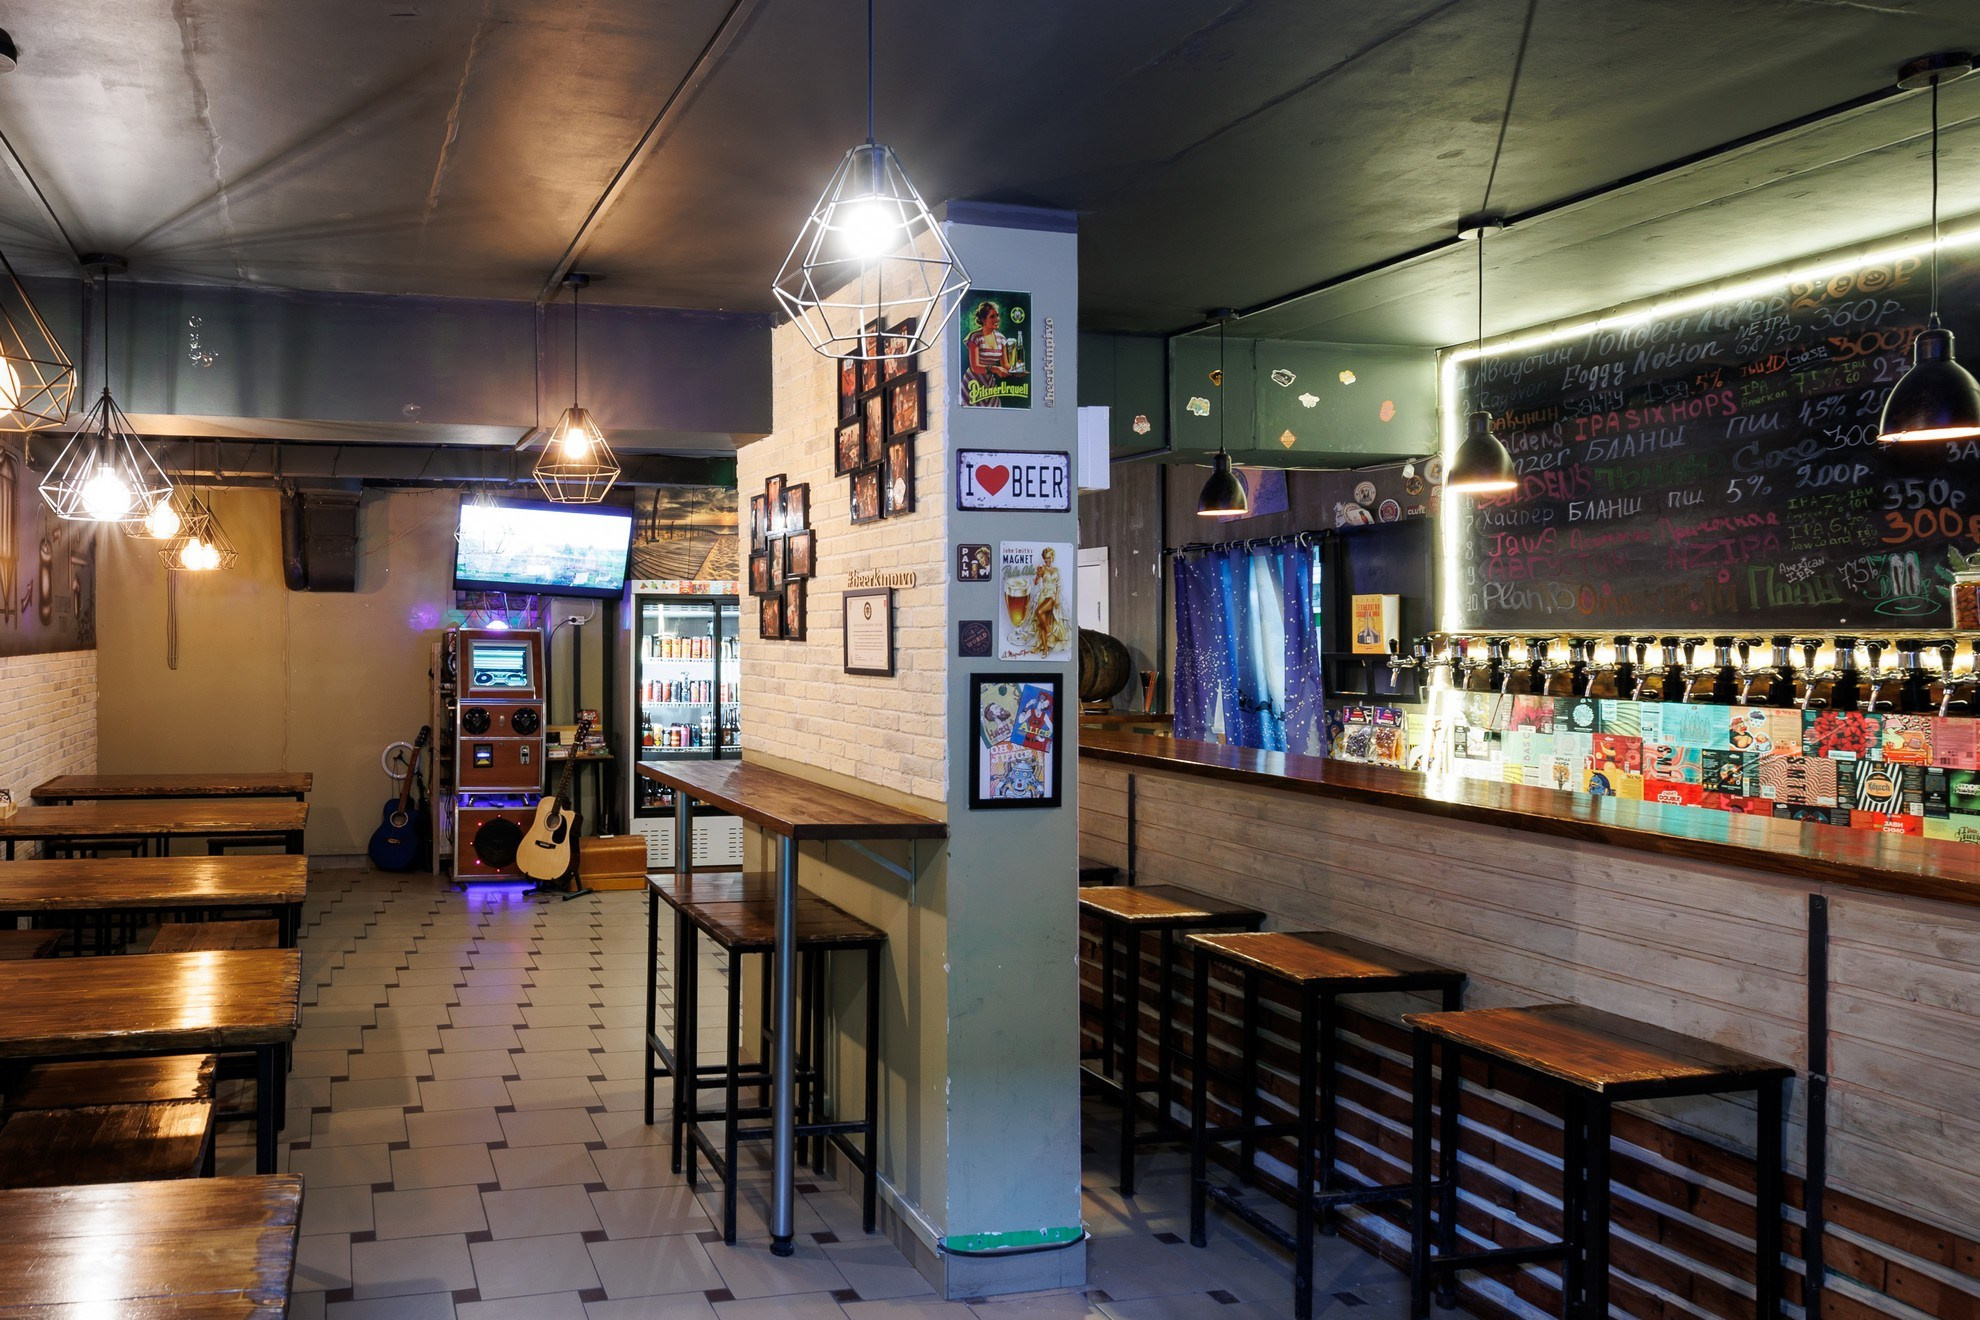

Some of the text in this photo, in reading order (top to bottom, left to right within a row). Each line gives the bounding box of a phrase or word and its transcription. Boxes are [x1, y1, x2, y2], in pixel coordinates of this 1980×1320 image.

[1474, 346, 1573, 386] Августин
[1633, 341, 1724, 375] Notion
[1575, 411, 1619, 441] IPA
[1624, 407, 1665, 429] SIX
[1671, 390, 1738, 423] HOPS
[966, 464, 1063, 498] I BEER
[1726, 475, 1773, 503] 5%
[1003, 554, 1033, 564] MAGNET
[1018, 722, 1051, 738] ALICE
